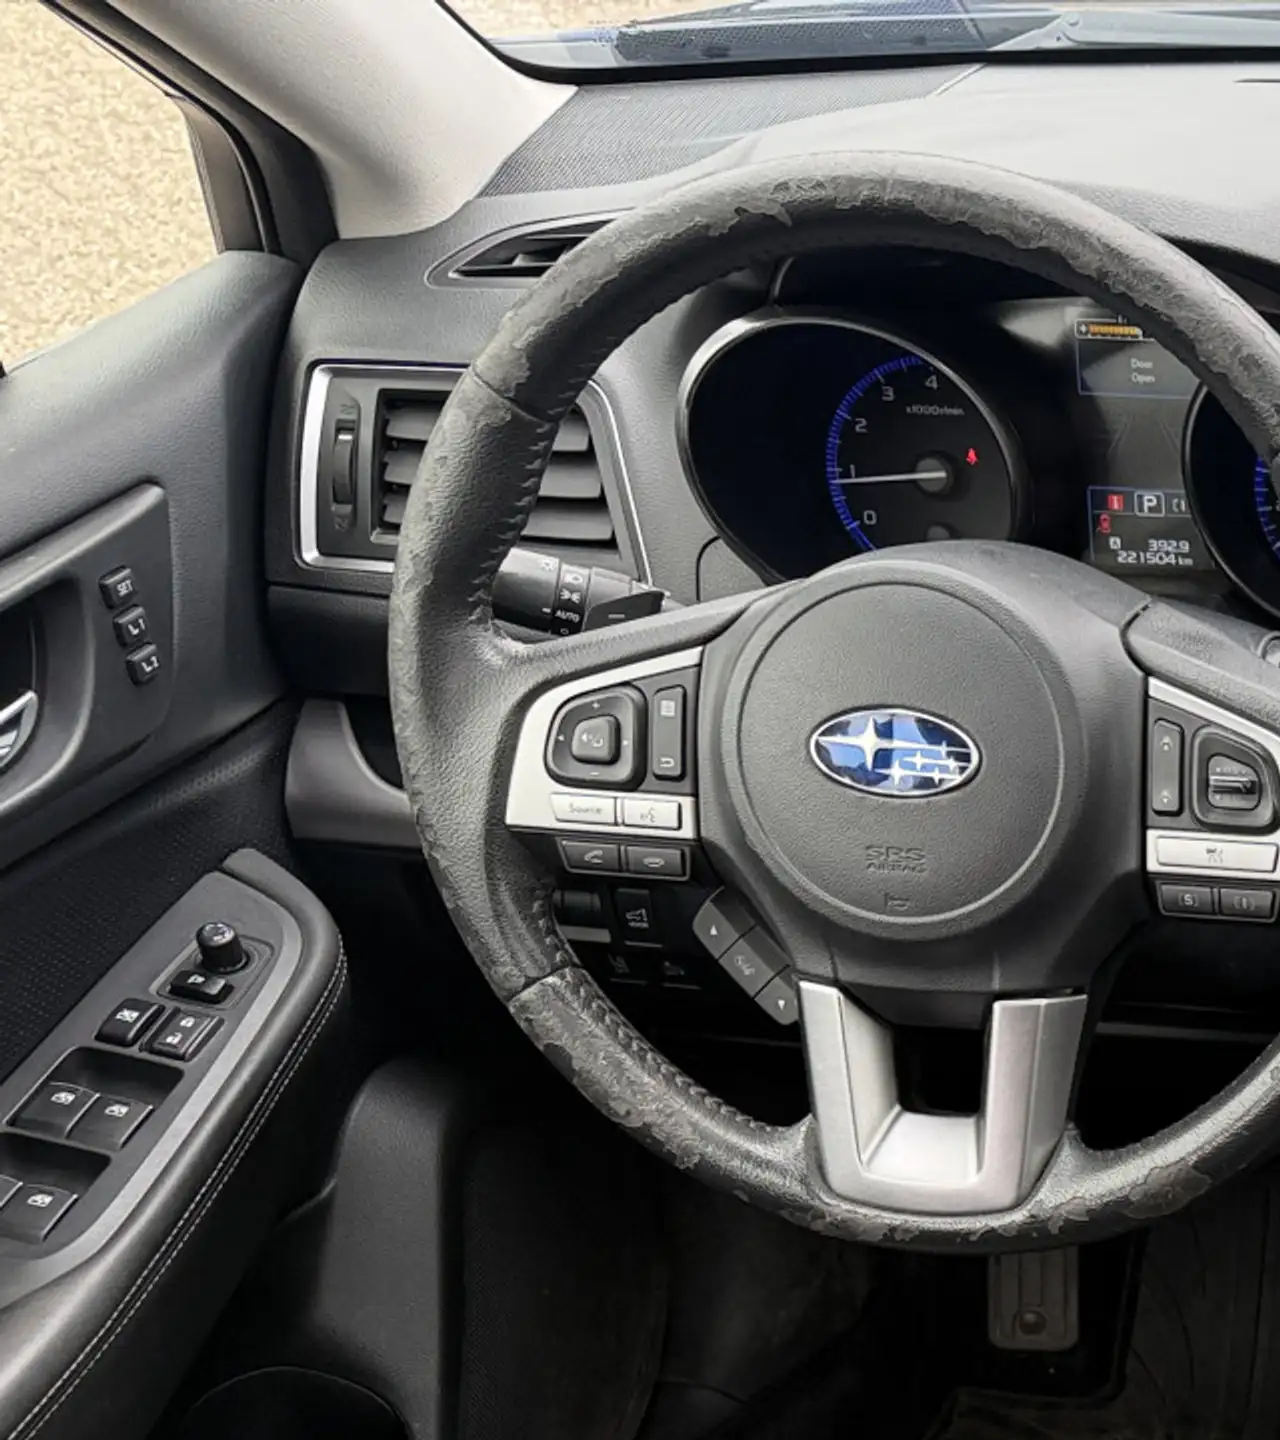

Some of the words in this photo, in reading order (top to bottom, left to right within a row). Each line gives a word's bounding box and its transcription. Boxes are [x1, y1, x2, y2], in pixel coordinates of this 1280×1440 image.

[924, 375, 938, 390] 4
[881, 386, 894, 401] 3
[854, 418, 868, 433] 2
[1143, 495, 1157, 513] P
[863, 510, 877, 525] 0
[1117, 550, 1176, 566] 221504
[116, 579, 133, 596] SET
[555, 609, 580, 624] AUTO
[128, 618, 146, 636] L1
[141, 655, 160, 673] L2
[865, 844, 926, 861] SRS
